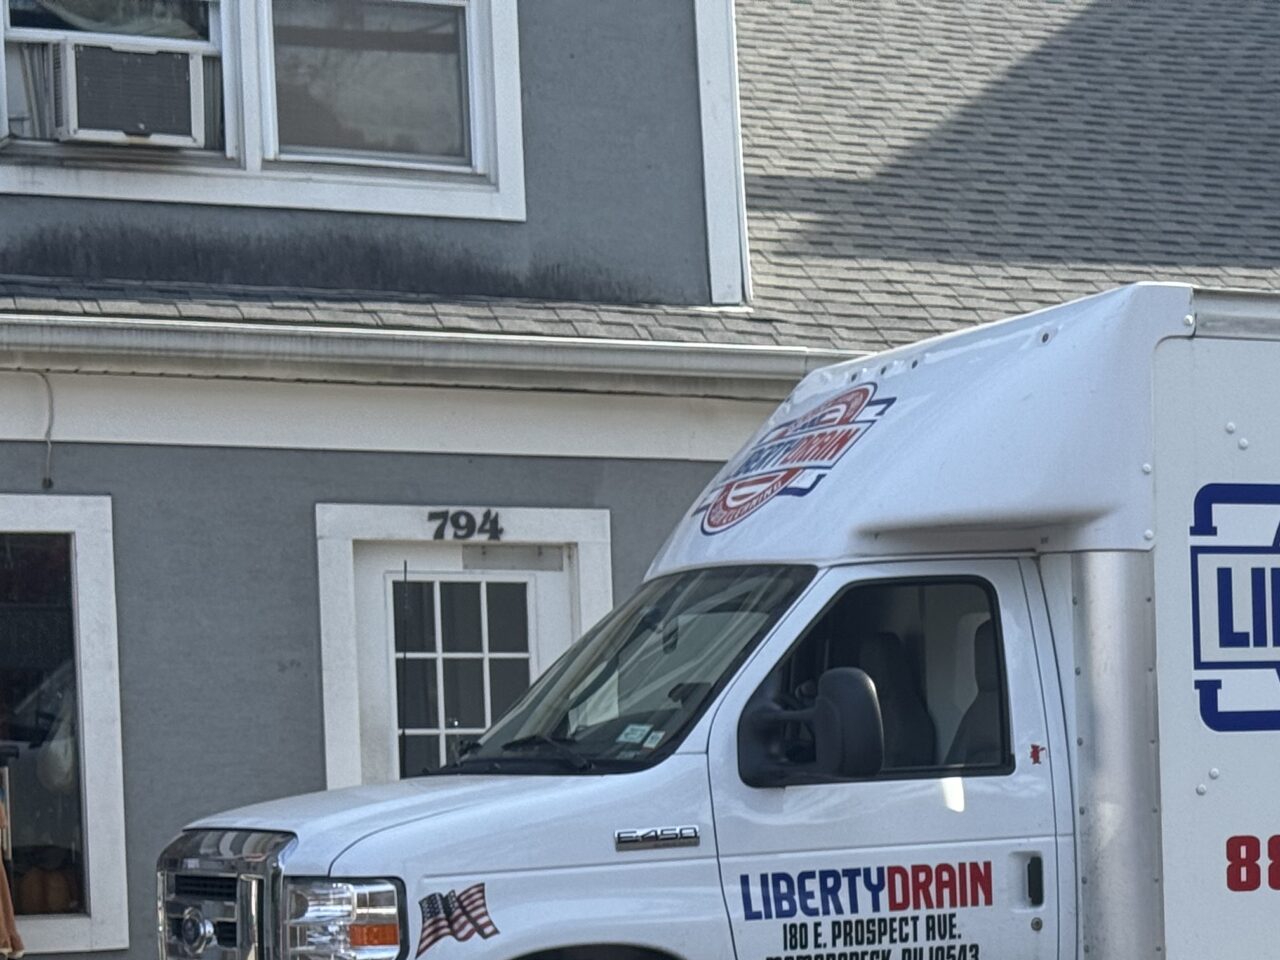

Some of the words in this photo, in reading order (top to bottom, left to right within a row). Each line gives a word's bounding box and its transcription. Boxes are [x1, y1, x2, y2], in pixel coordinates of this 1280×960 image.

[427, 509, 504, 541] 794
[739, 861, 994, 921] LIBERTYDRAIN
[783, 922, 808, 951] 180
[813, 921, 827, 949] E.
[831, 916, 919, 947] PROSPECT
[925, 913, 962, 942] AVE.
